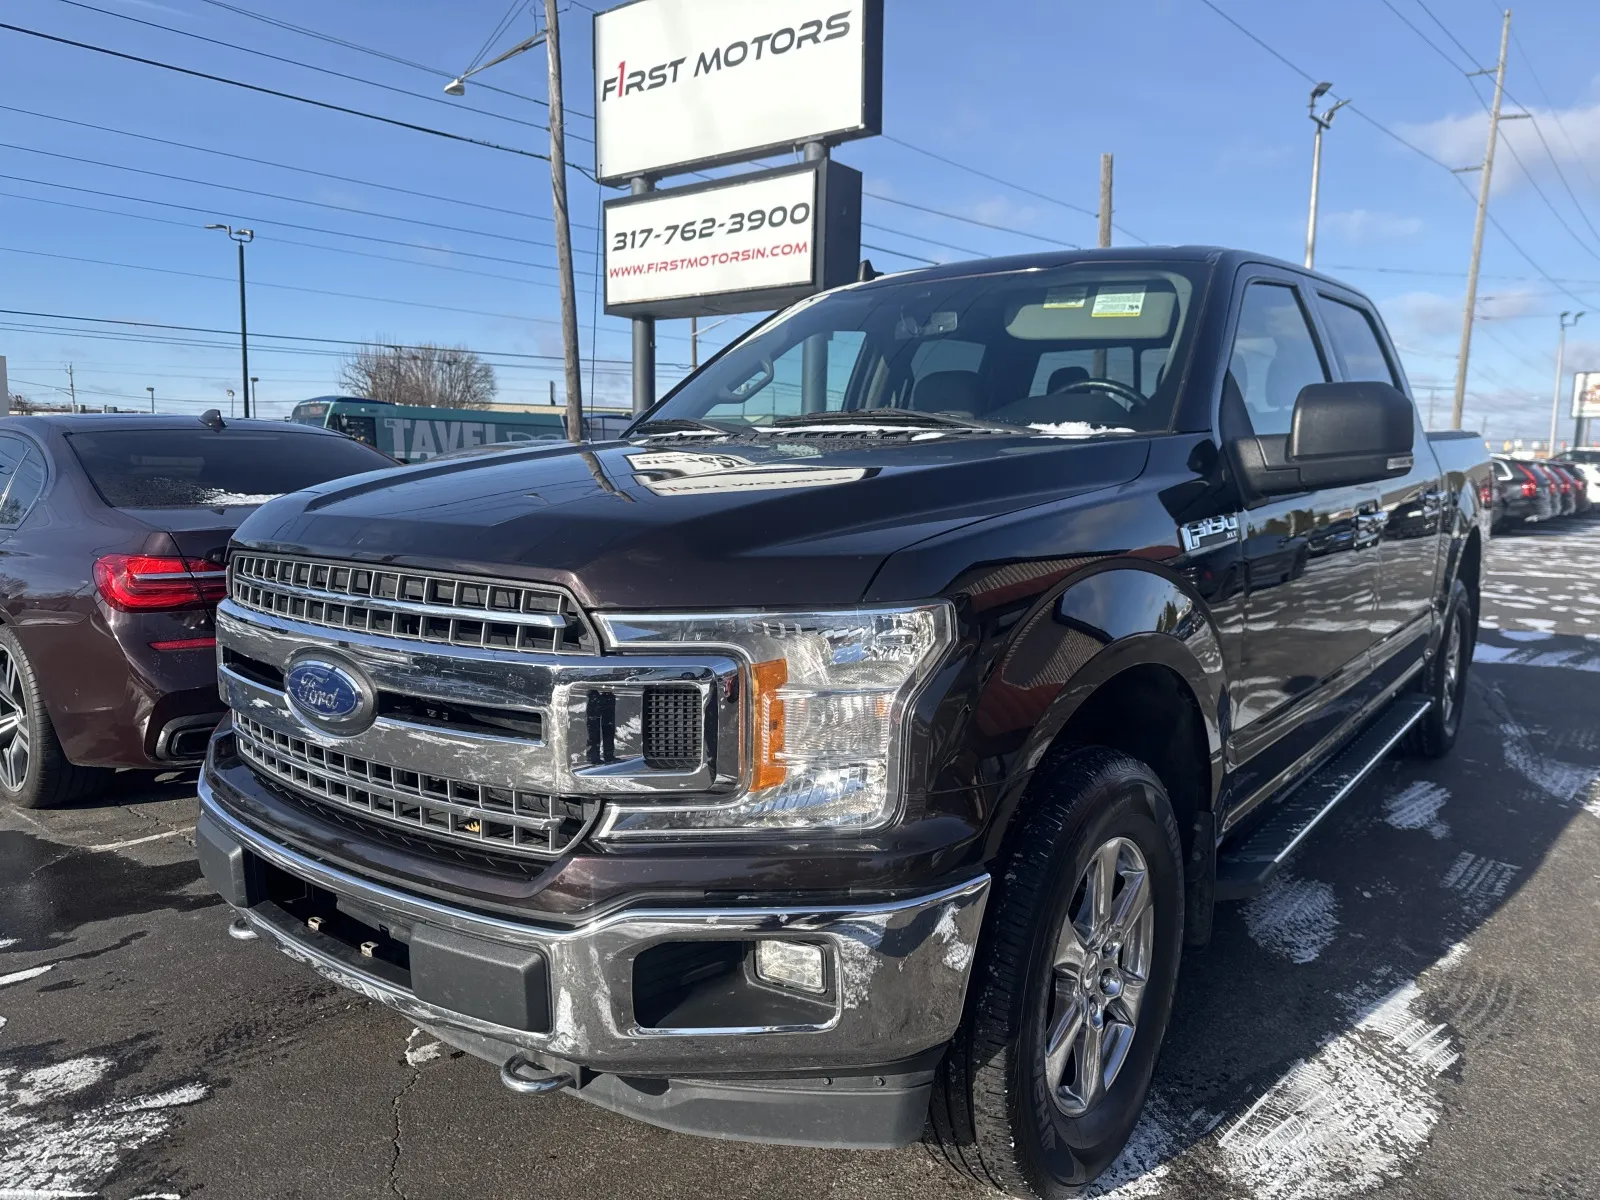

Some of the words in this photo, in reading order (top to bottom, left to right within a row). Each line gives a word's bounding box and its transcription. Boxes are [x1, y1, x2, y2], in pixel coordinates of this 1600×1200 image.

[694, 10, 852, 78] MOTORS
[612, 202, 810, 251] 317-762-3900
[609, 242, 807, 278] WWW.FIRSTMOTORSIN.COM
[1225, 531, 1237, 539] XLT
[298, 672, 340, 709] Ford
